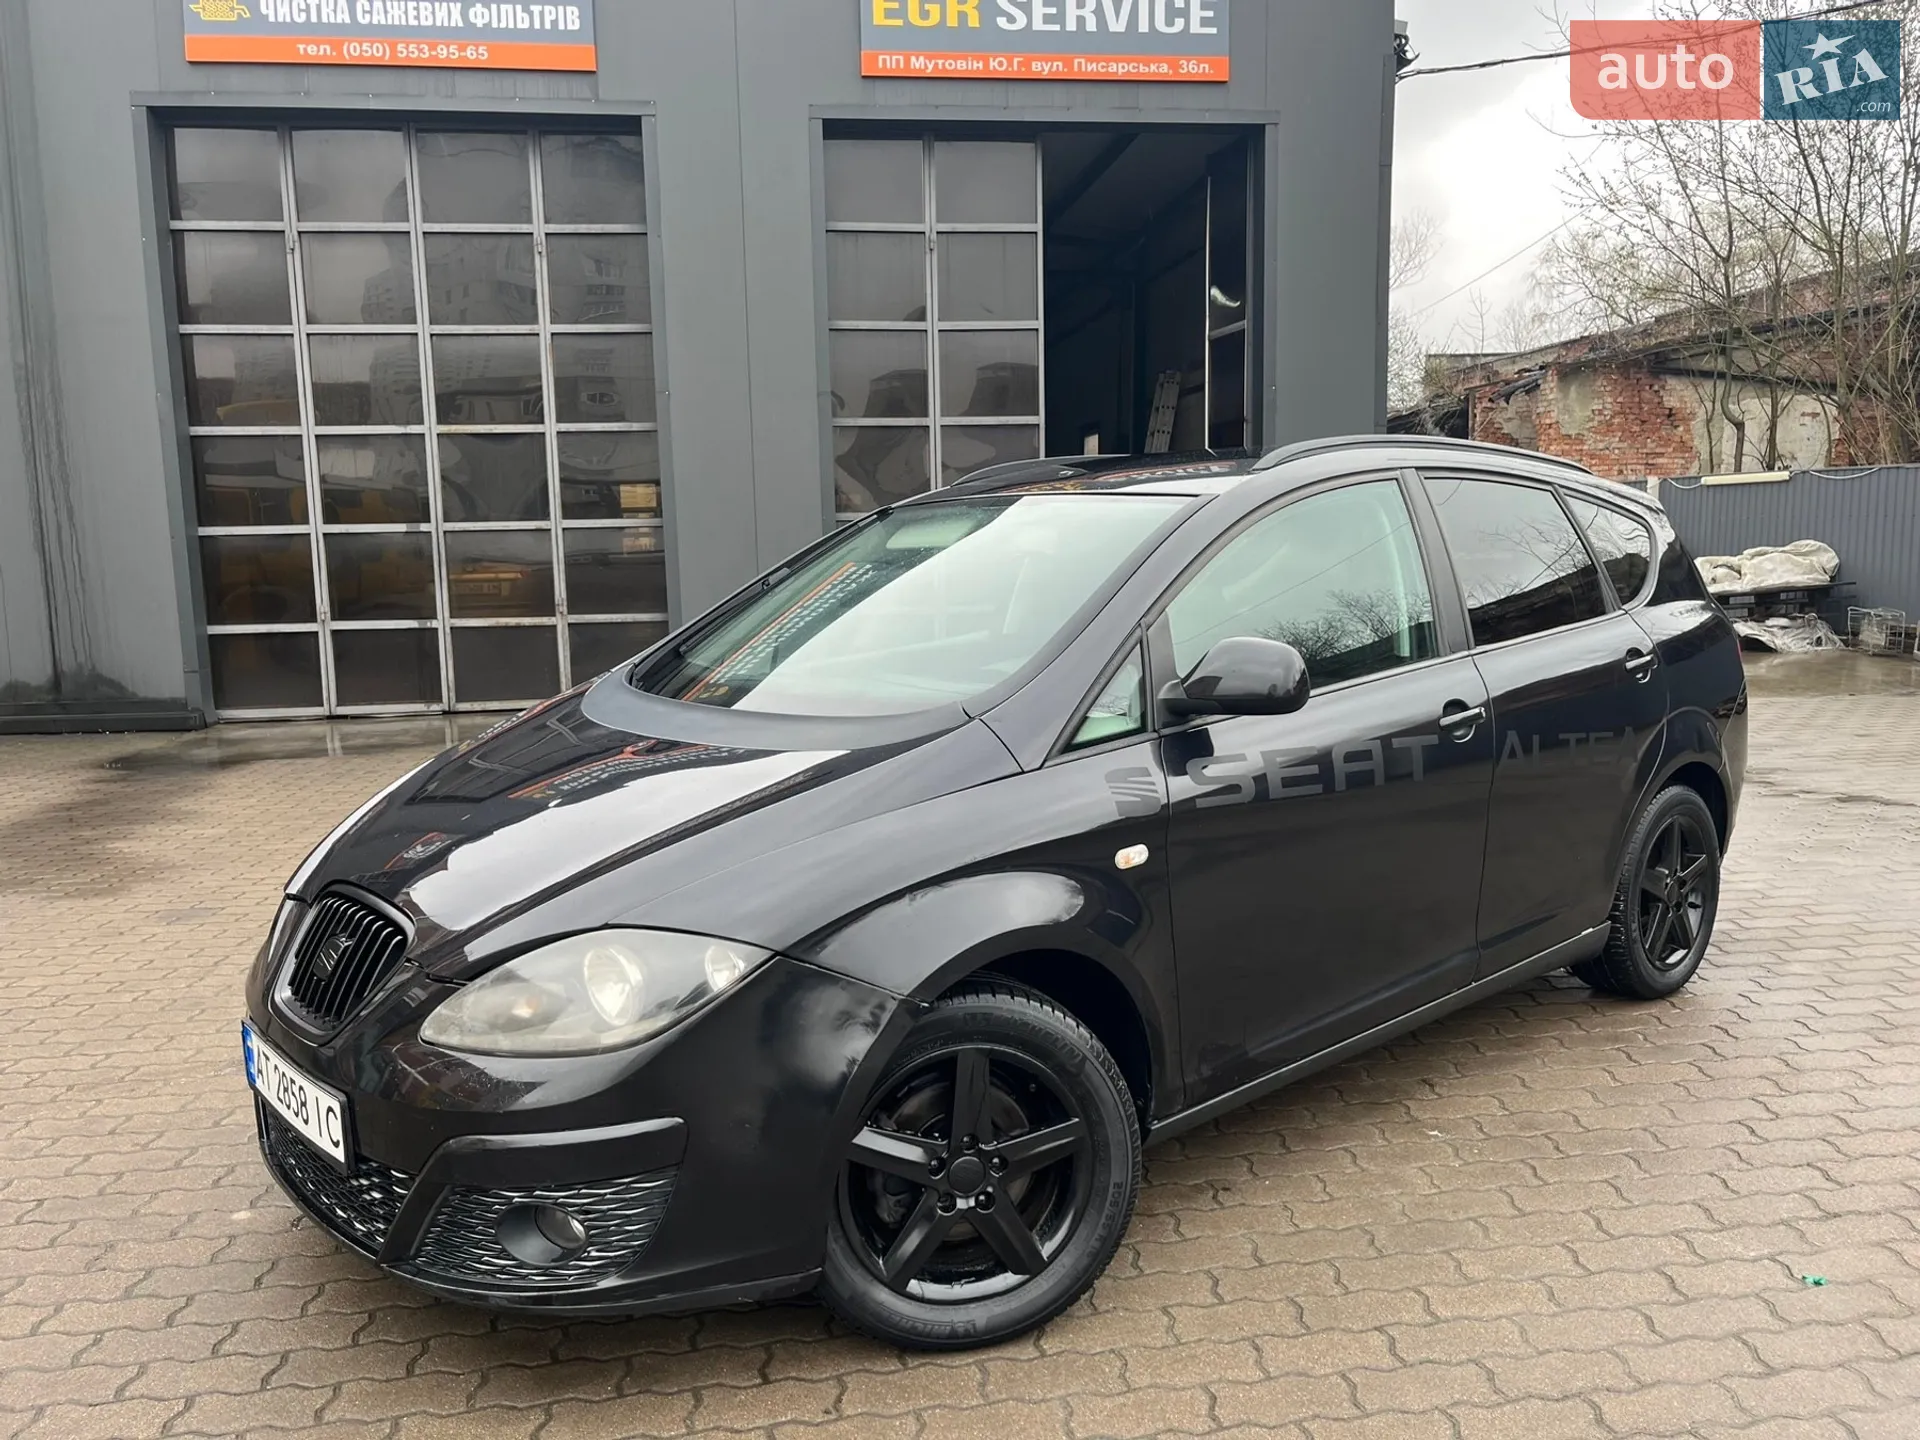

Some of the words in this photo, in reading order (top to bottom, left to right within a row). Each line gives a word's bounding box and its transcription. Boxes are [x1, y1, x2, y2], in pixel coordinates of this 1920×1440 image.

[260, 0, 351, 24] ЧИСТКА
[356, 0, 464, 27] САЖЕВИХ
[468, 3, 581, 30] ФІЛЬТРІВ
[873, 0, 980, 28] EGR
[996, 0, 1218, 34] SERVICE
[296, 43, 337, 56] тел.
[342, 41, 390, 60] (050)
[396, 43, 489, 60] 553-95-65
[878, 54, 904, 69] ПП
[910, 55, 984, 73] Мутовін
[989, 57, 1026, 71] Ю.Г.
[1031, 60, 1068, 75] вул.
[1073, 58, 1173, 75] Писарська,
[1178, 60, 1214, 74] 36л.
[1185, 736, 1438, 808] SEAT
[256, 1045, 271, 1092] AT
[273, 1063, 310, 1126] 2858
[315, 1095, 341, 1149] IC
